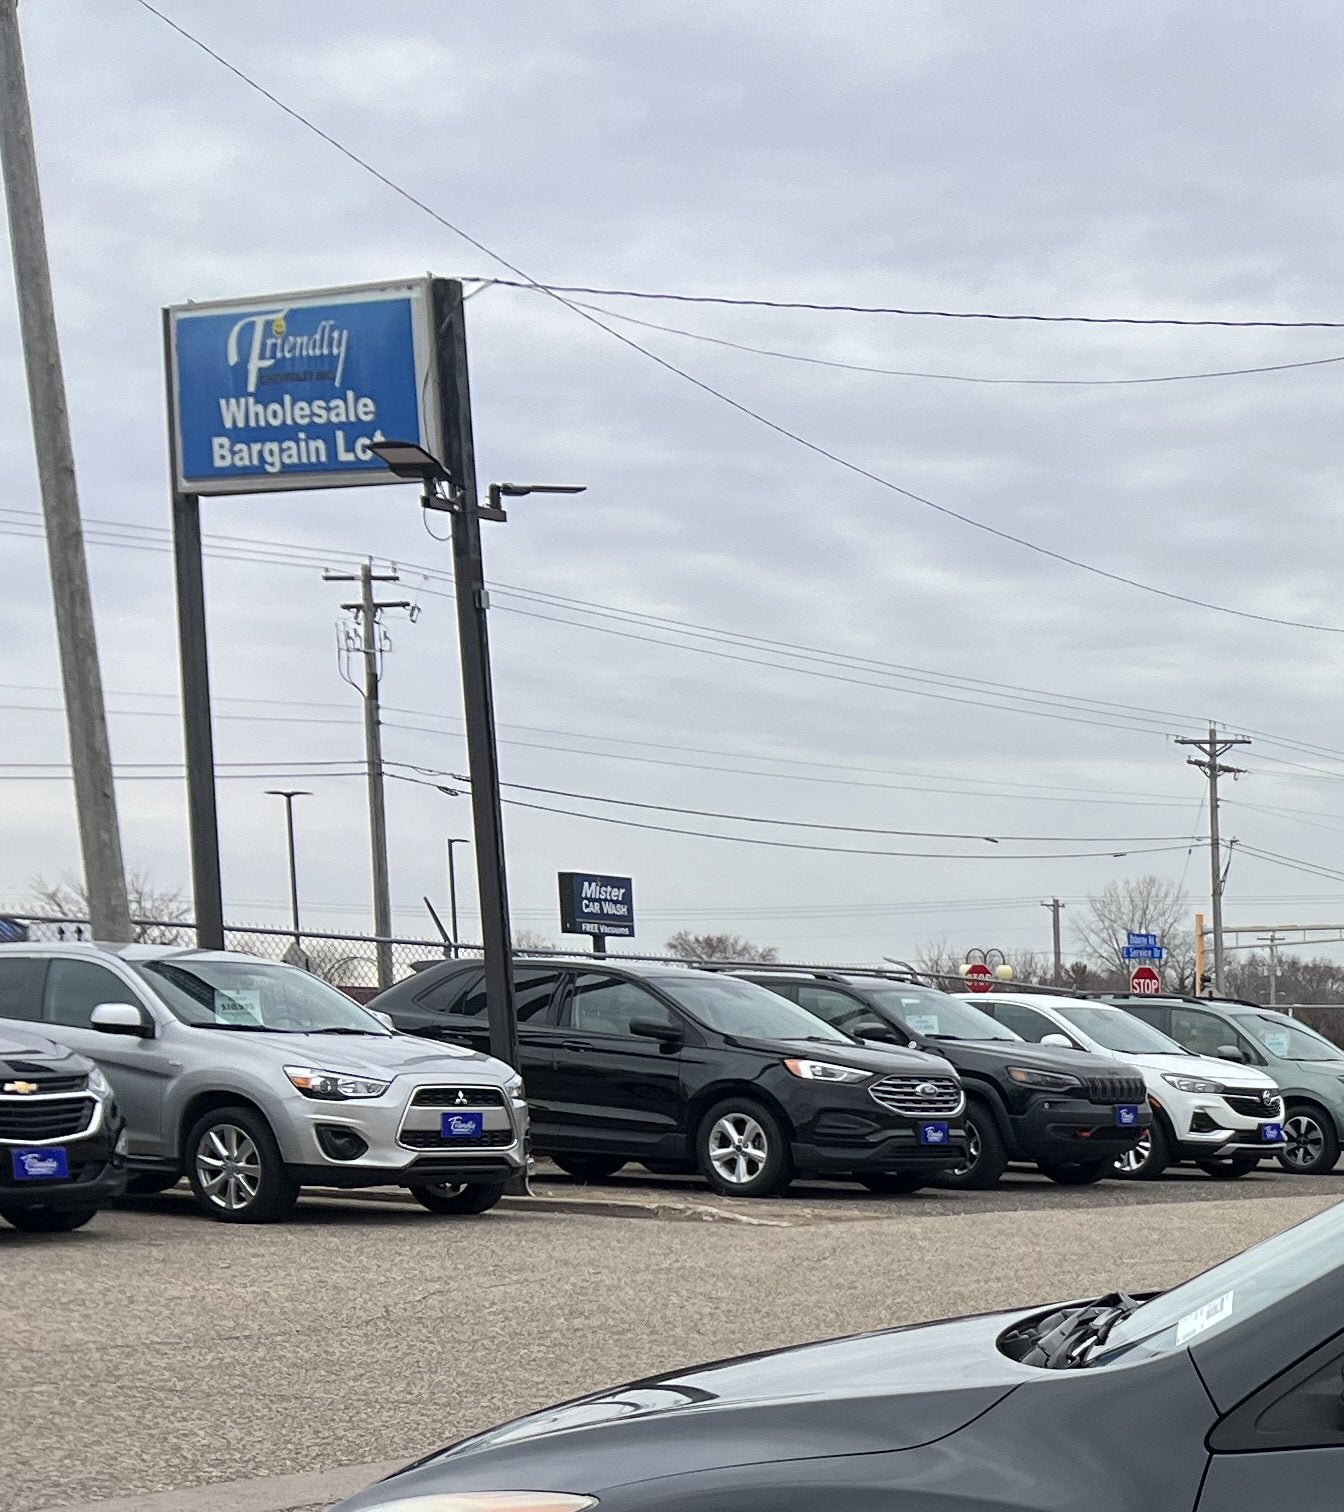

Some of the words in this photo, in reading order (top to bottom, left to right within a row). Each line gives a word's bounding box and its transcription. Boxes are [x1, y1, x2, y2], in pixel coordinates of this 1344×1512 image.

[227, 307, 348, 392] Friendly
[219, 390, 376, 429] Wholesale
[212, 432, 327, 474] Bargain
[581, 881, 626, 900] Mister
[582, 900, 600, 913] CAR
[602, 901, 628, 915] WASH
[581, 923, 599, 932] FREE
[1132, 979, 1159, 993] STOP
